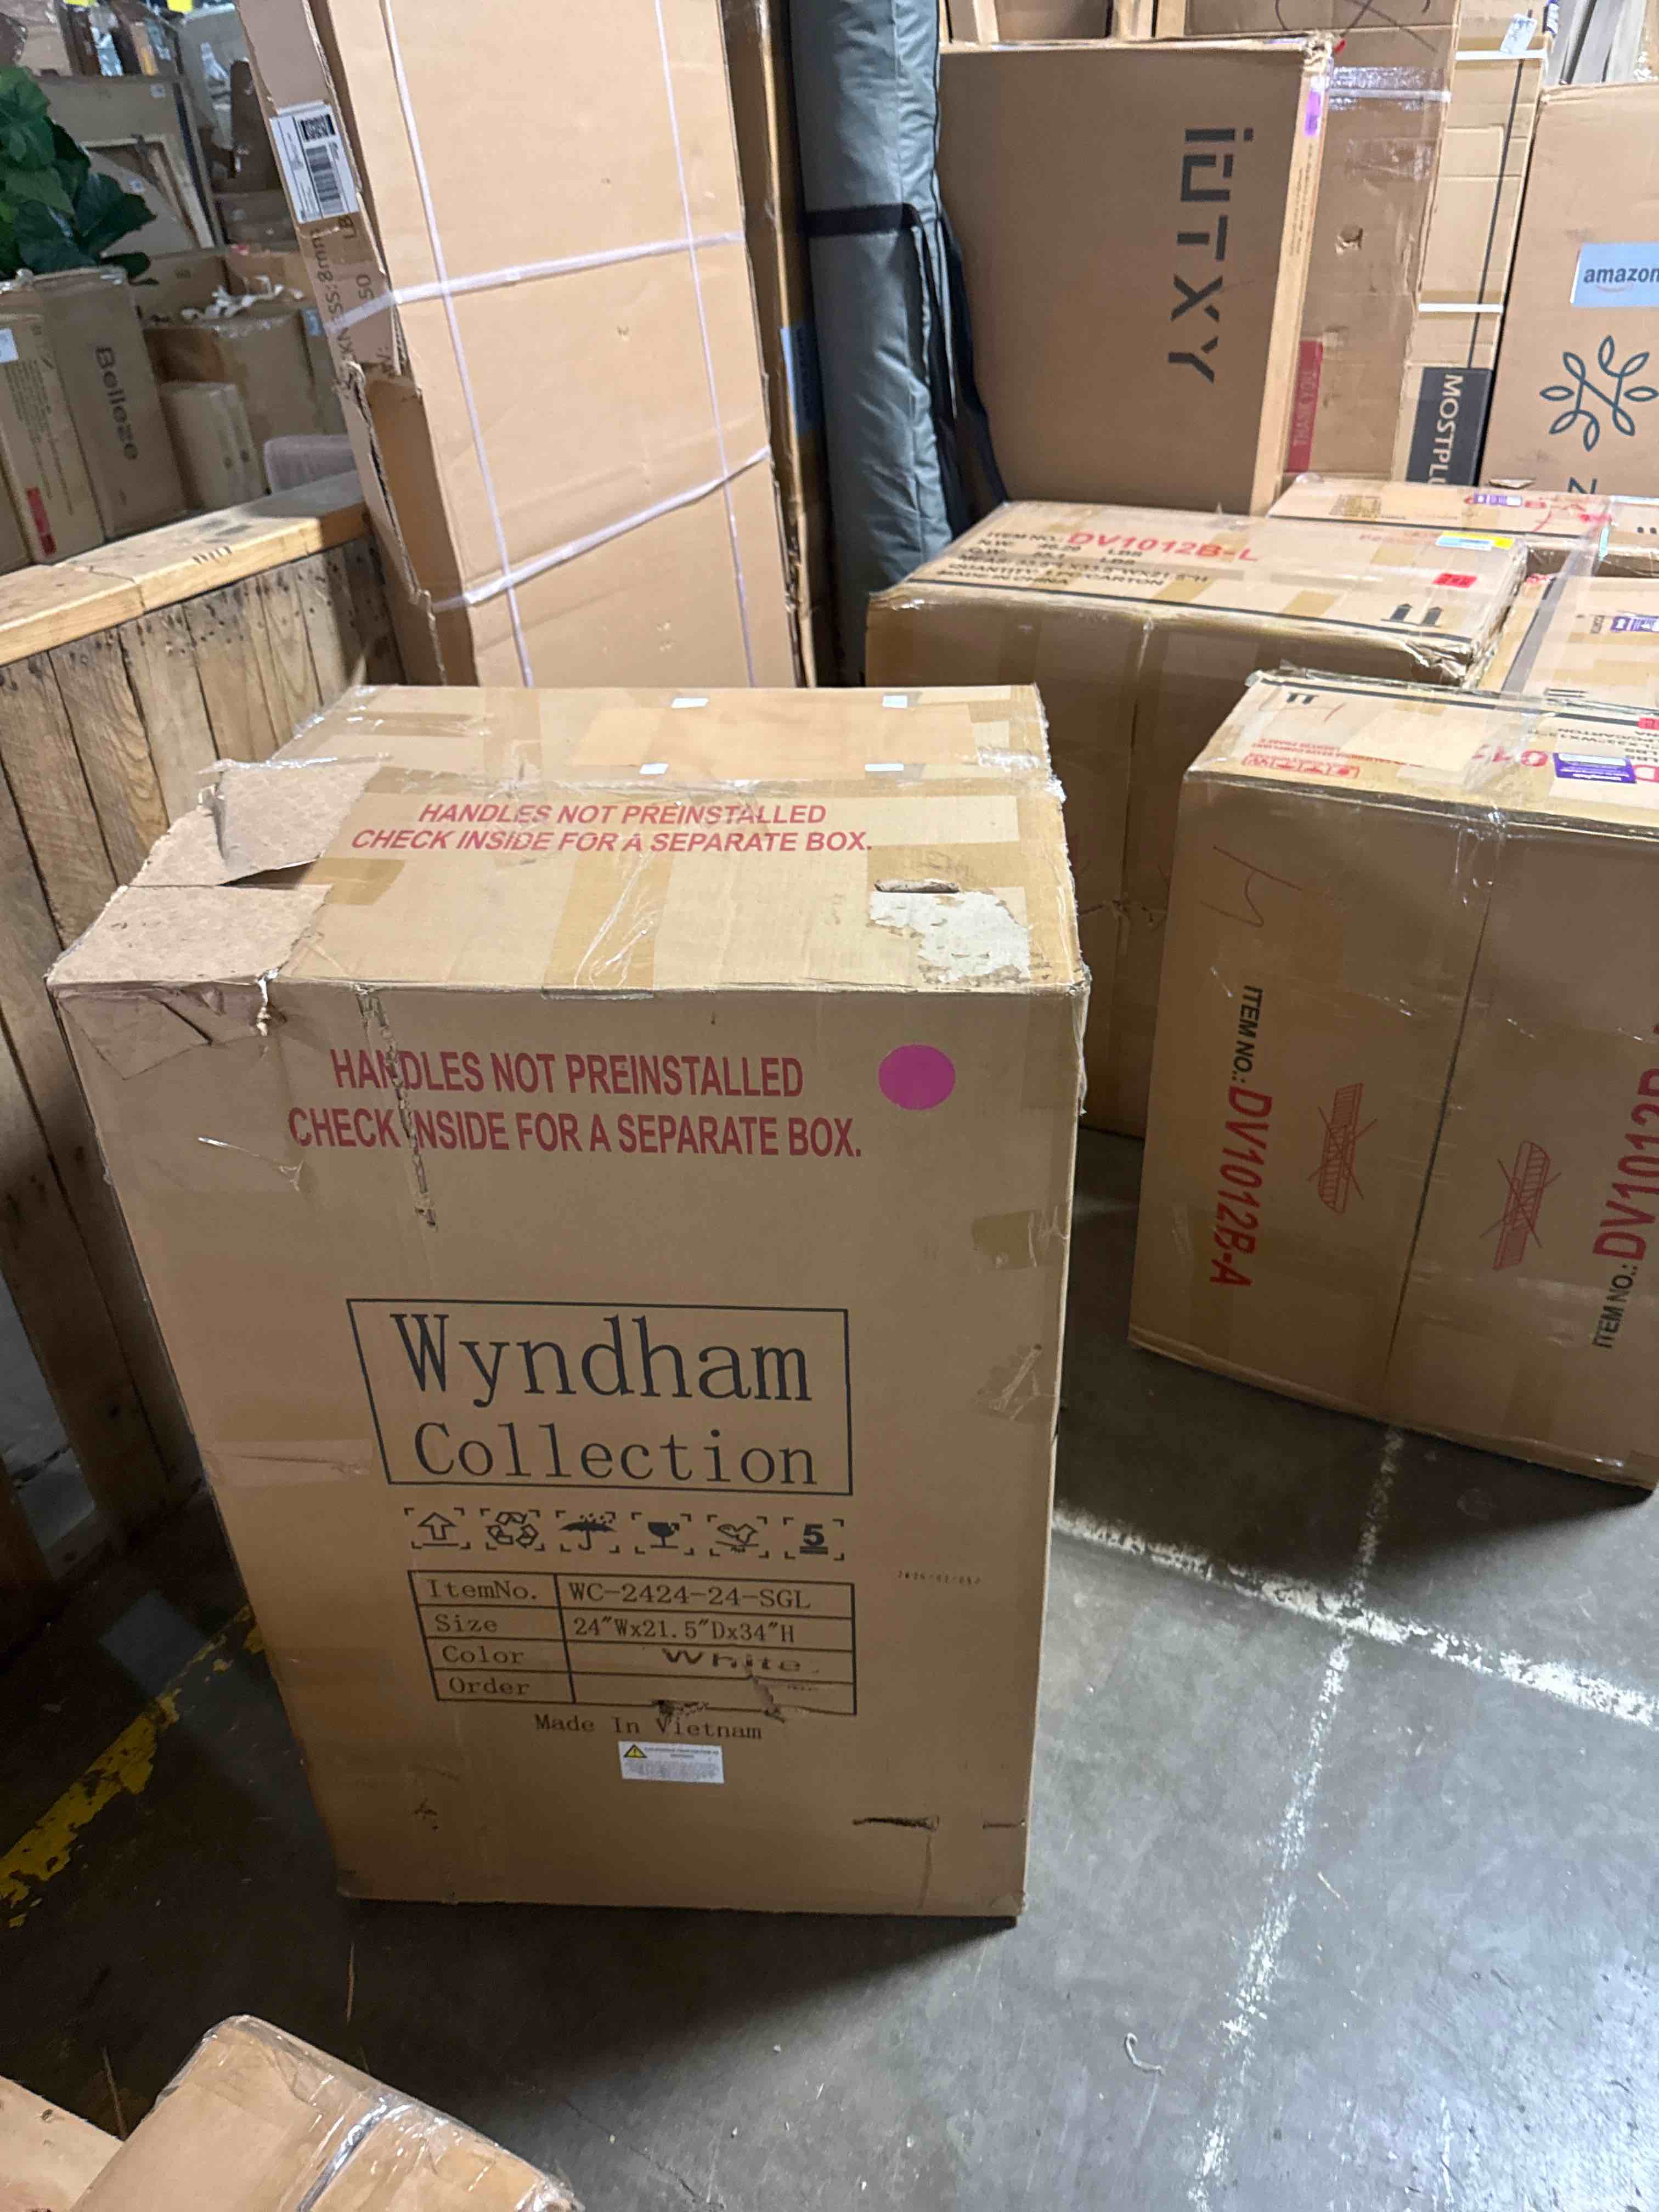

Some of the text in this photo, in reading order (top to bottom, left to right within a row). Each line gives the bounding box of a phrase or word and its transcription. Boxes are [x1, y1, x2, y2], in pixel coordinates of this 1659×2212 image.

[1583, 268, 1659, 283] amazon
[1068, 531, 1259, 563] DV1012B-L
[419, 804, 827, 825] HANDLES NOT PREINSTALLED
[352, 829, 873, 853] CHECK INSIDE FOR A SEPARATE BOX.
[1239, 985, 1263, 1039] ITEM
[330, 1048, 804, 1097] HANDLES NOT PREINSTALLED
[288, 1107, 862, 1157] CHECK NSIDE FOR A SEPARATE BOX.
[1210, 1085, 1273, 1288] DV1012B-A
[1592, 1303, 1624, 1348] ITEM
[390, 1313, 813, 1408] Wyndham
[414, 1421, 817, 1486] Collection
[429, 1578, 811, 1611] ItemNo. WC-2424-24-SGL
[435, 1613, 498, 1633] Size
[442, 1646, 524, 1665] Color
[449, 1678, 530, 1696] Order
[535, 1713, 762, 1740] Made In Vietnam
